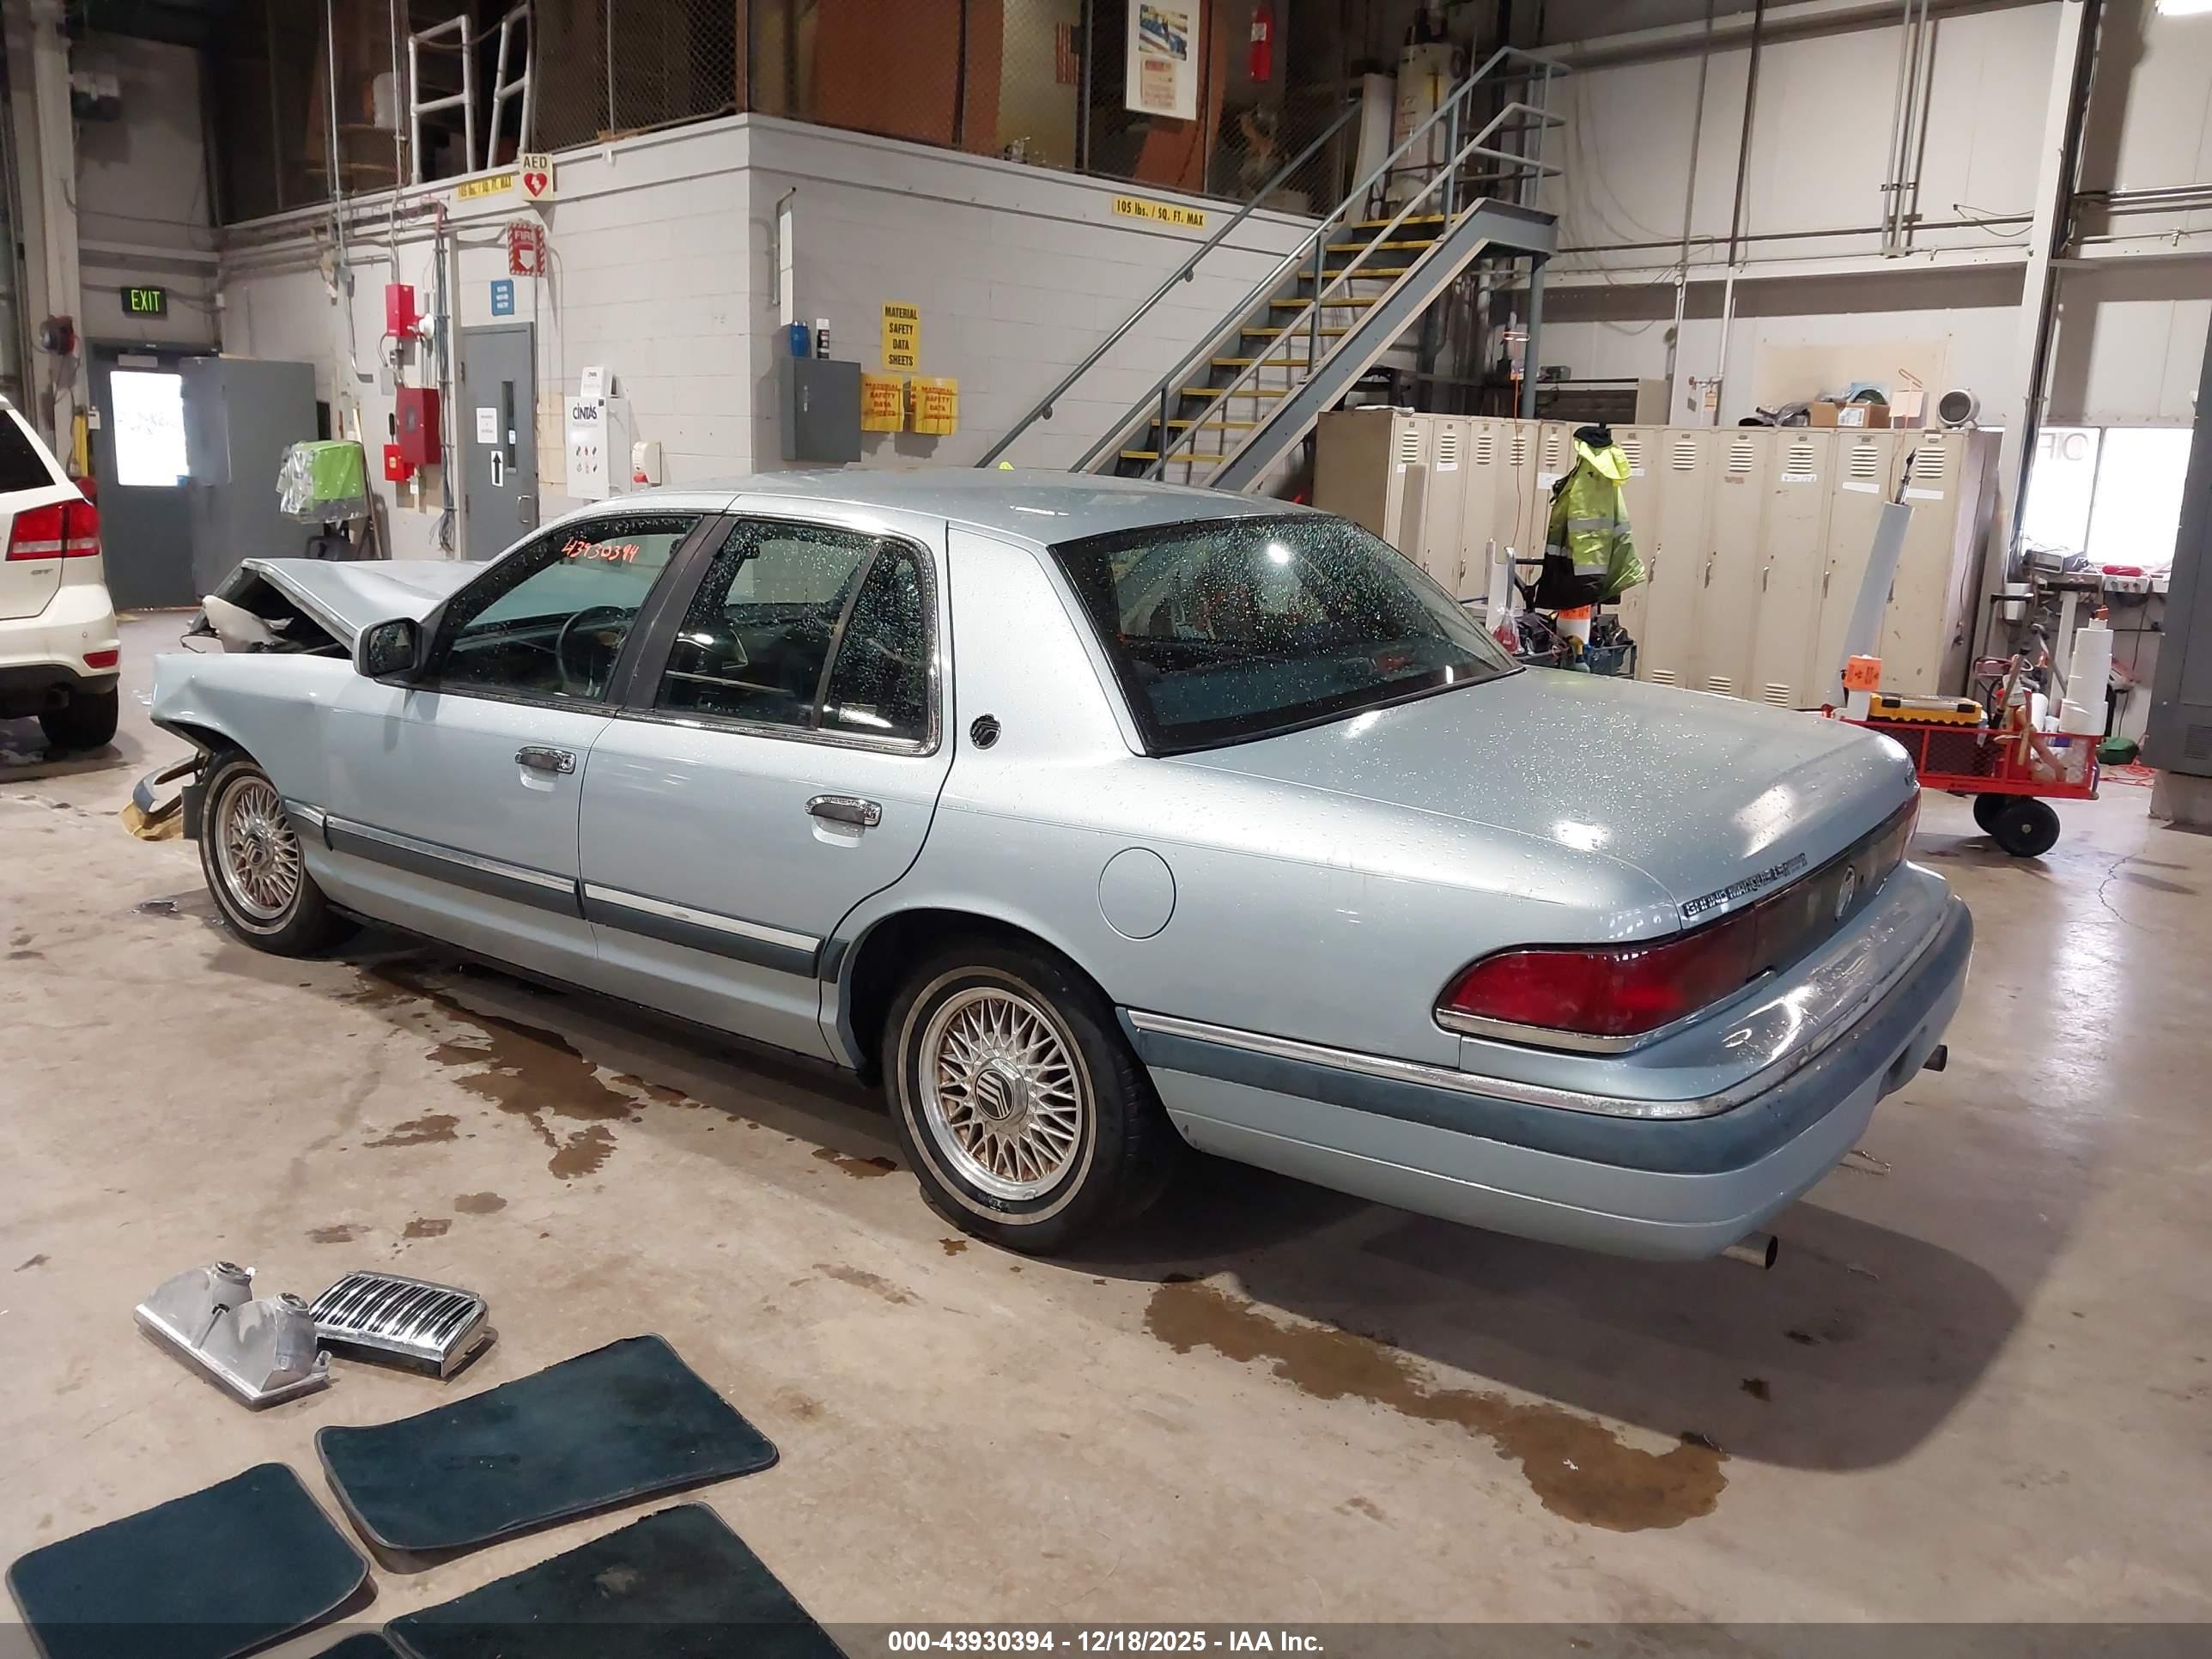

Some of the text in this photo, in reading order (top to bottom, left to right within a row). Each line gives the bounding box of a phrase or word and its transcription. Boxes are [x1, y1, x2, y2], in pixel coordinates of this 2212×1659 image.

[523, 155, 548, 169] AED
[1117, 199, 1204, 227] 105 lbs. / SQ. FT. MAX
[131, 289, 161, 312] EXIT
[884, 306, 918, 320] MATERIAL
[889, 322, 914, 336] SAFETY
[893, 338, 910, 351] DATA
[888, 354, 914, 367] SHEETS
[572, 403, 598, 420] CINTAS
[561, 536, 641, 563] 43930394
